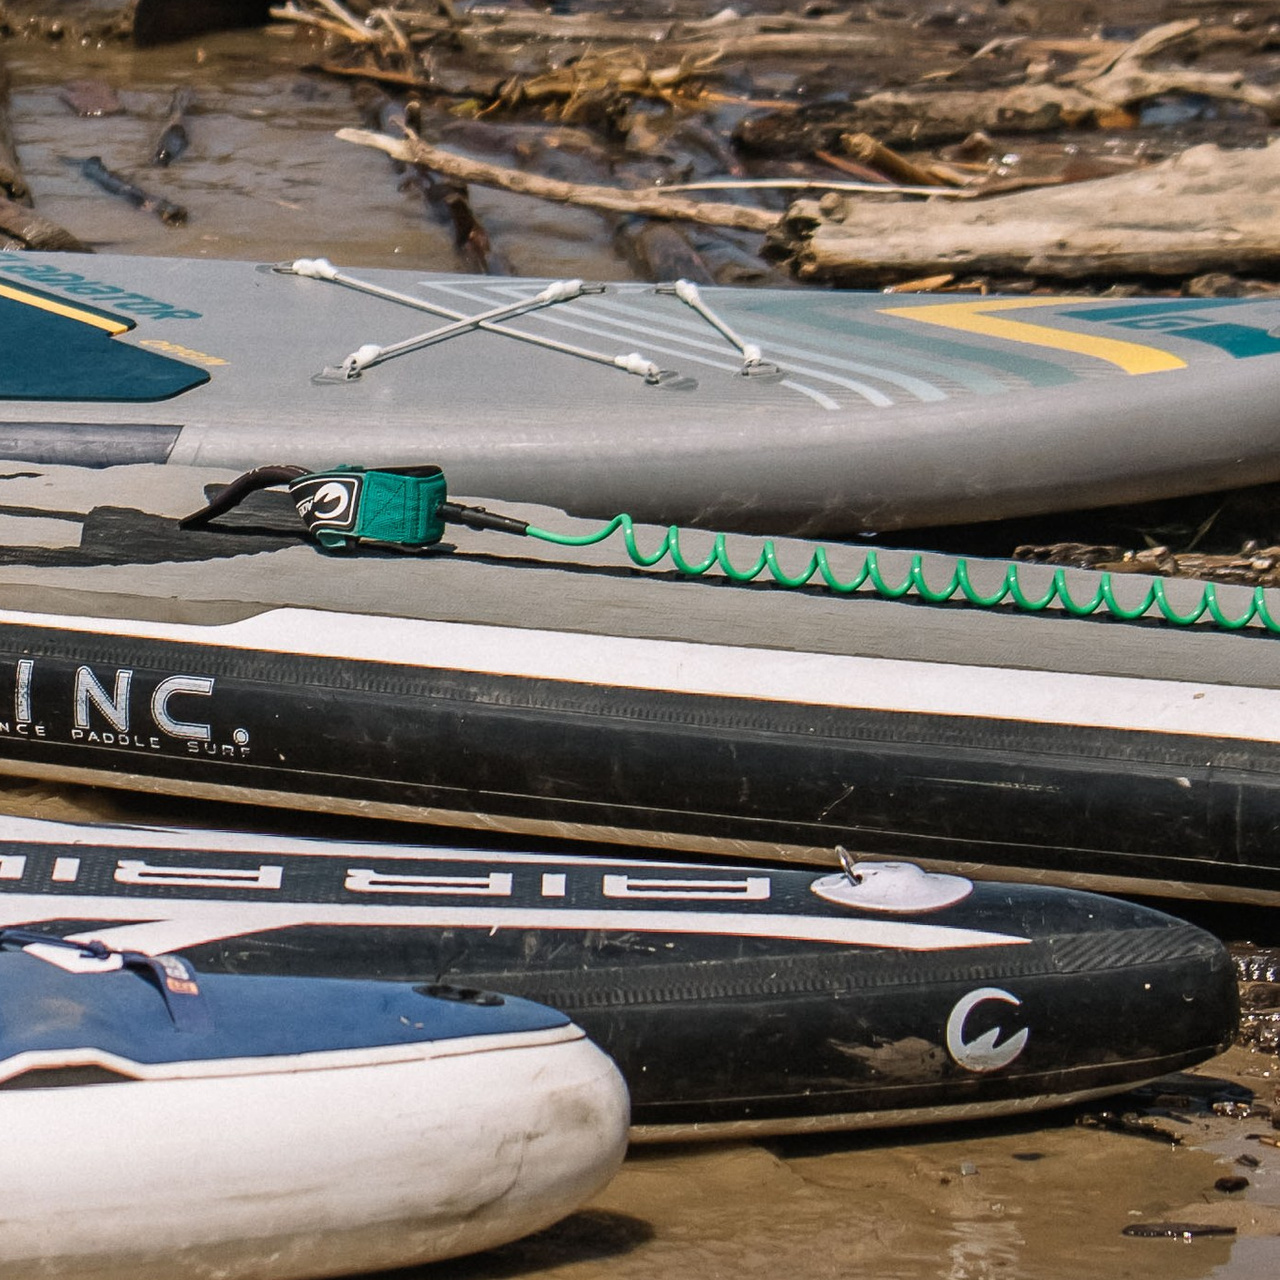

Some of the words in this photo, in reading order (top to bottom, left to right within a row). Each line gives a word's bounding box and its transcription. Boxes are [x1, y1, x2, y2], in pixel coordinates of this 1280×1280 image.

[14, 658, 250, 746] INC.
[71, 728, 161, 749] PADDLE
[344, 867, 771, 902] AIR
